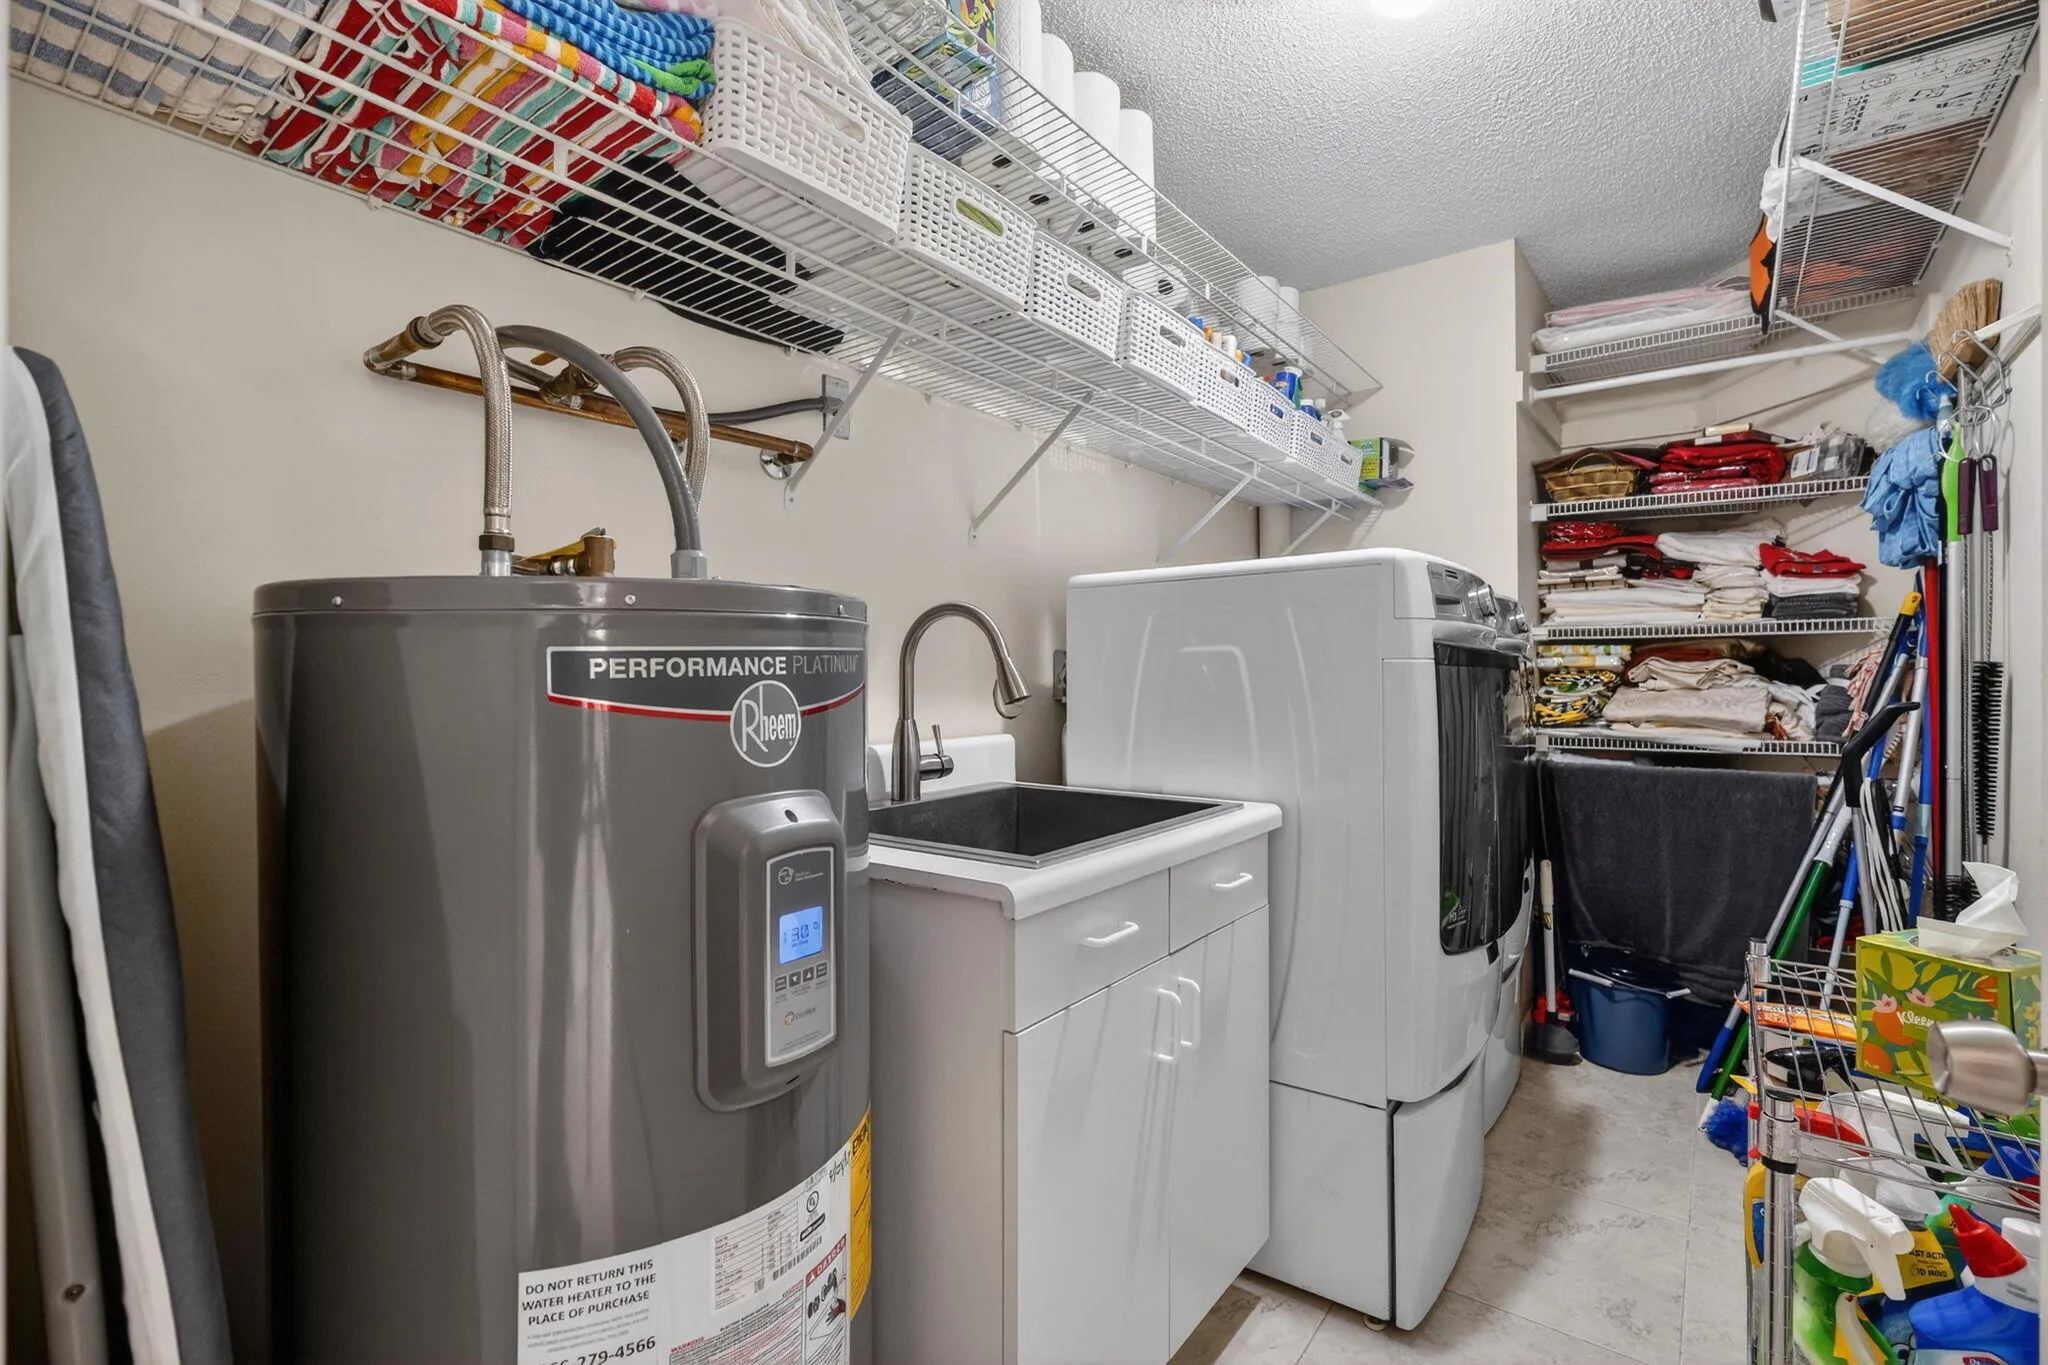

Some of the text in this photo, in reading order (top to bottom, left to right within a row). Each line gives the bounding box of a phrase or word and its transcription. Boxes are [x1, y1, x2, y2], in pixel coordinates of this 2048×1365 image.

[588, 655, 788, 680] PERFORMANCE
[741, 684, 796, 753] Rheem
[522, 1273, 657, 1312] WATER HEATER TO THE
[525, 1259, 654, 1295] DO NOT RETURN THIS
[528, 1311, 565, 1326] PLACE
[568, 1306, 585, 1319] OF
[587, 1290, 650, 1315] PURCHASE
